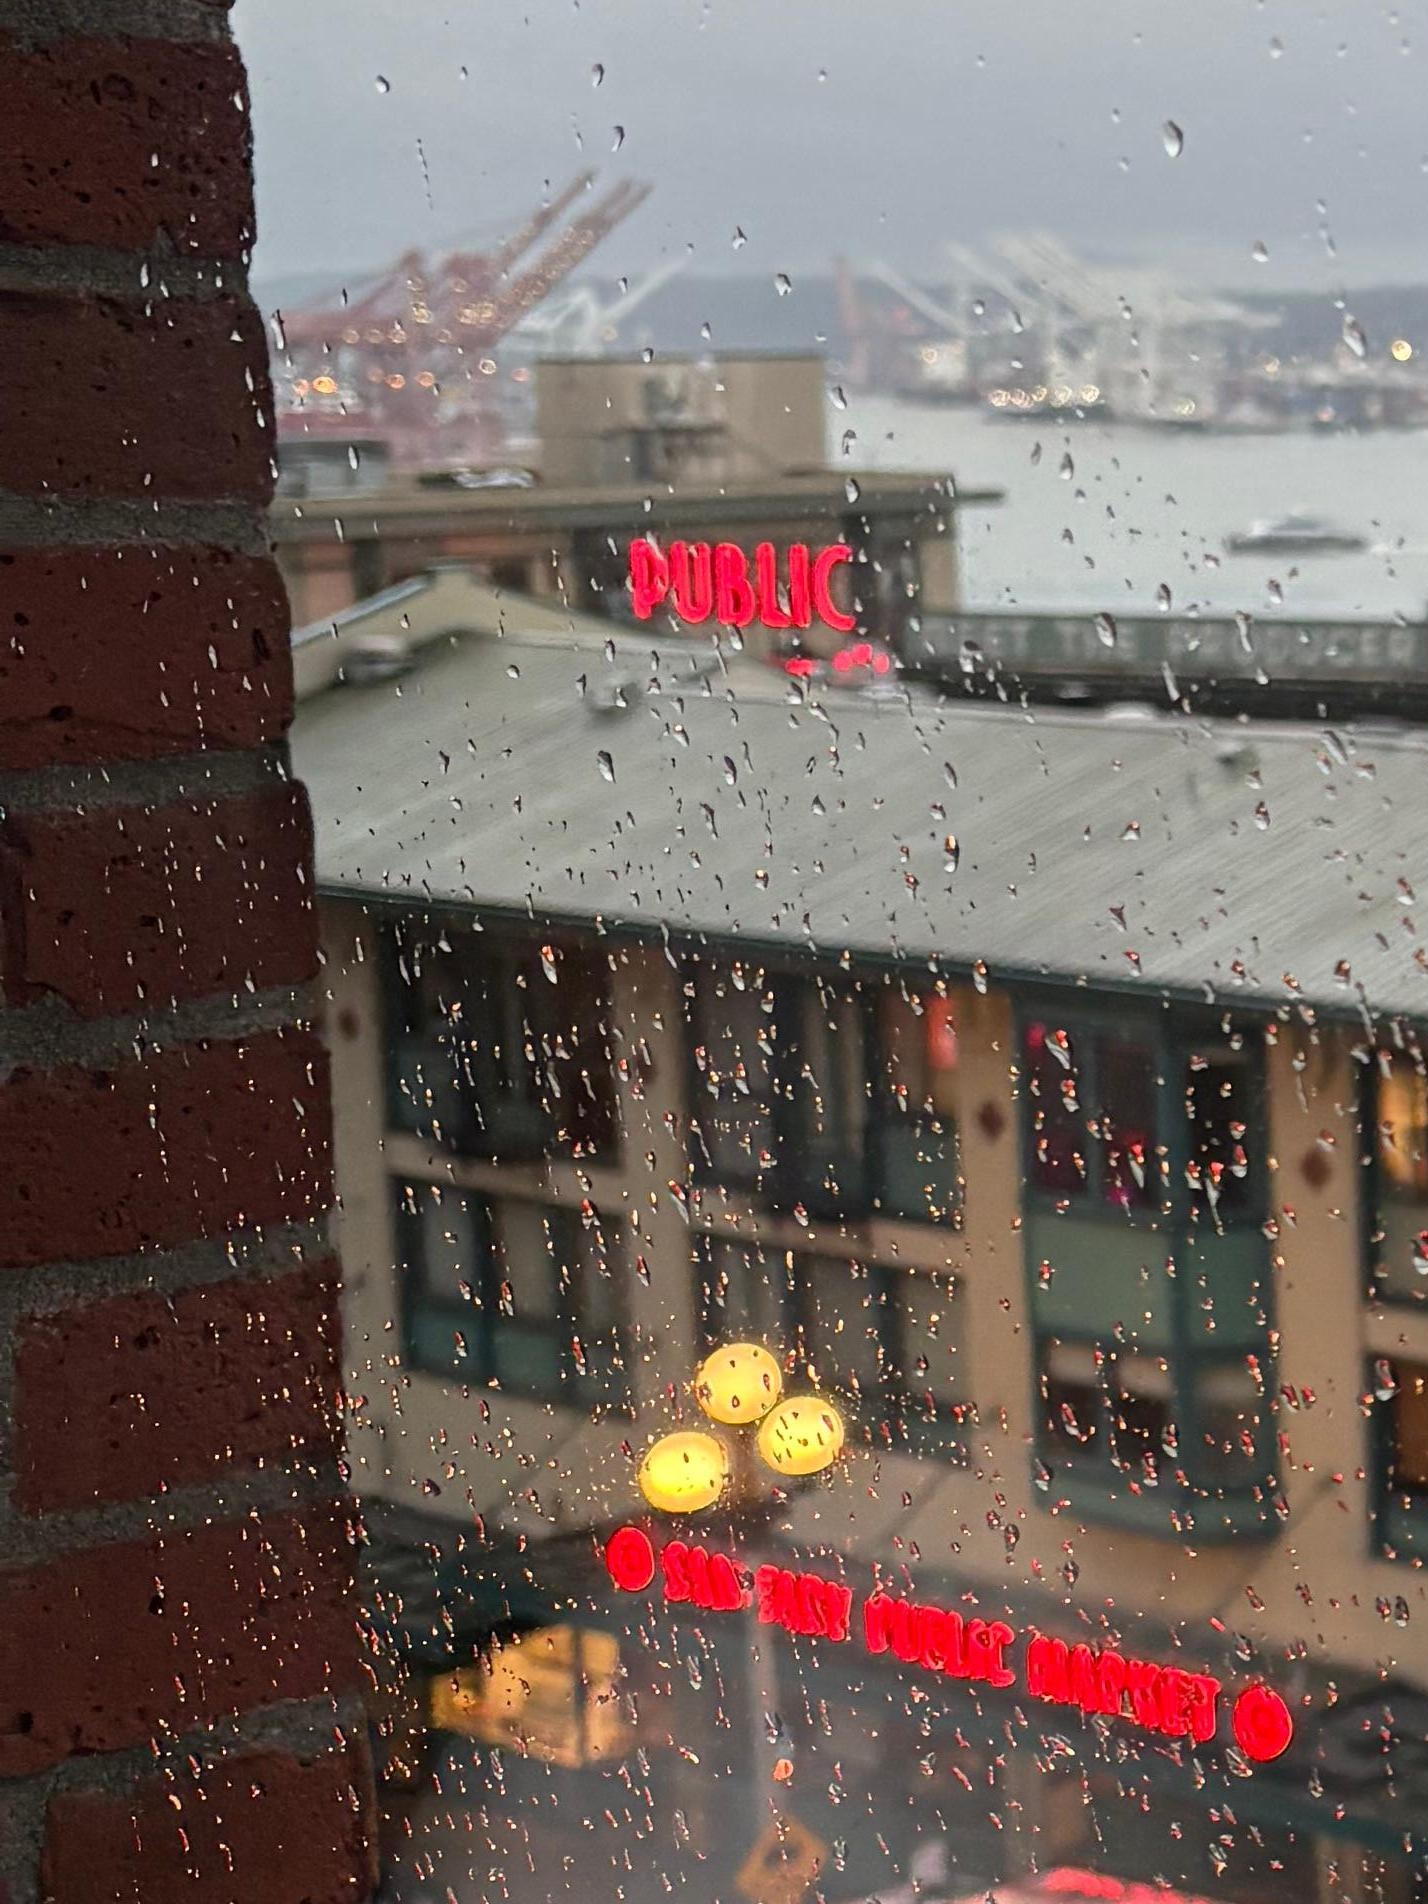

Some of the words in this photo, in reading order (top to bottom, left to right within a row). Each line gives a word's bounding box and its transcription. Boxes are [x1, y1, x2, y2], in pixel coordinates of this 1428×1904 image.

[629, 538, 856, 632] PUBLIC
[863, 1594, 1016, 1688] PUBLIC
[1027, 1635, 1222, 1743] MARKET
